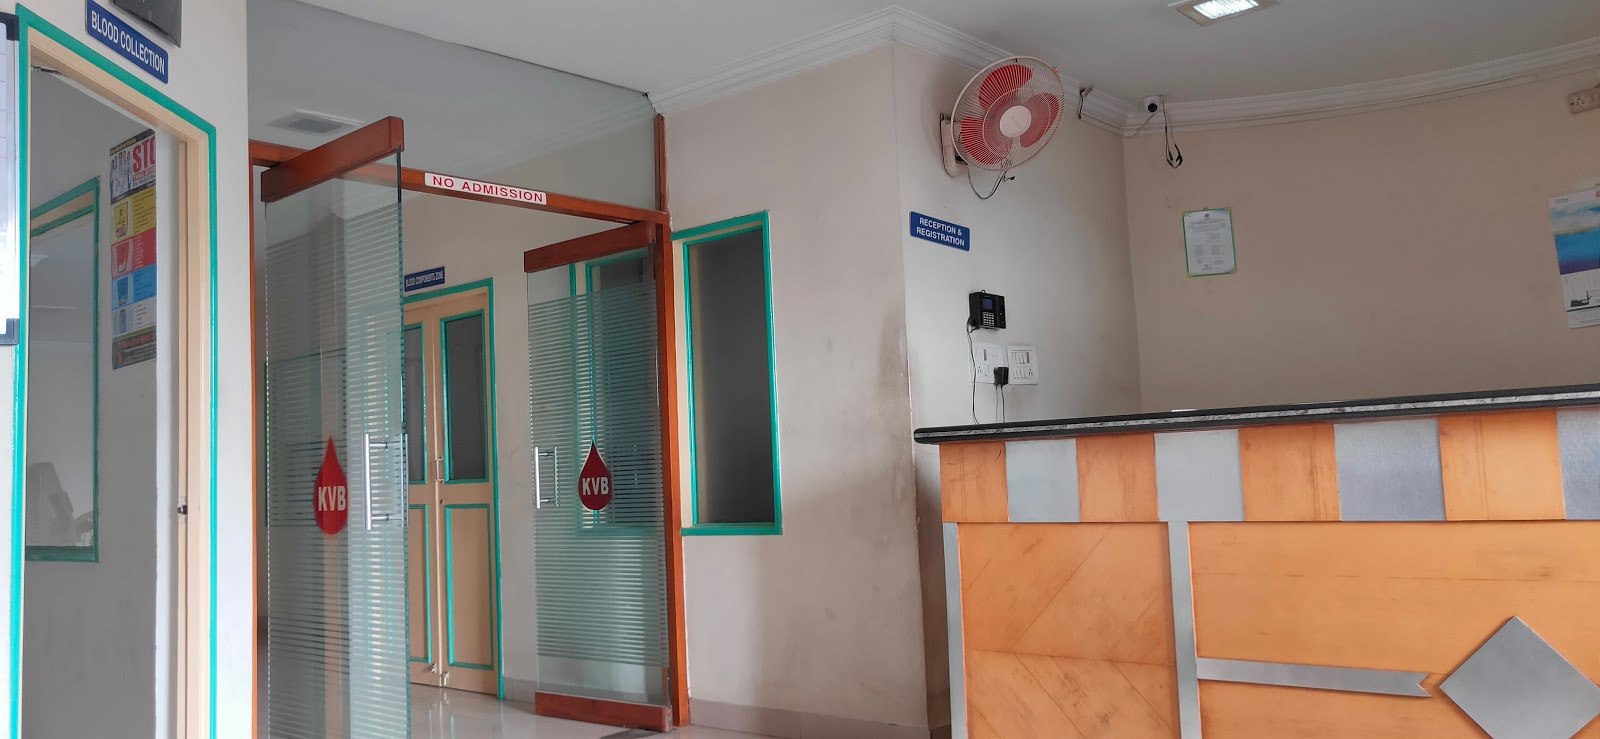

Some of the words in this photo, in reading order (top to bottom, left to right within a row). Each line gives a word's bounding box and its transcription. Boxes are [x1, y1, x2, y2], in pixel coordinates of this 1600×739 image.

[91, 10, 119, 43] BLOOD
[120, 31, 165, 75] COLLECTION
[433, 176, 454, 187] NO
[462, 181, 542, 203] ADMISSION
[916, 227, 965, 246] REGISTRATION
[919, 218, 956, 234] RECEPTION
[582, 477, 609, 496] KVB
[318, 486, 347, 512] KVB
